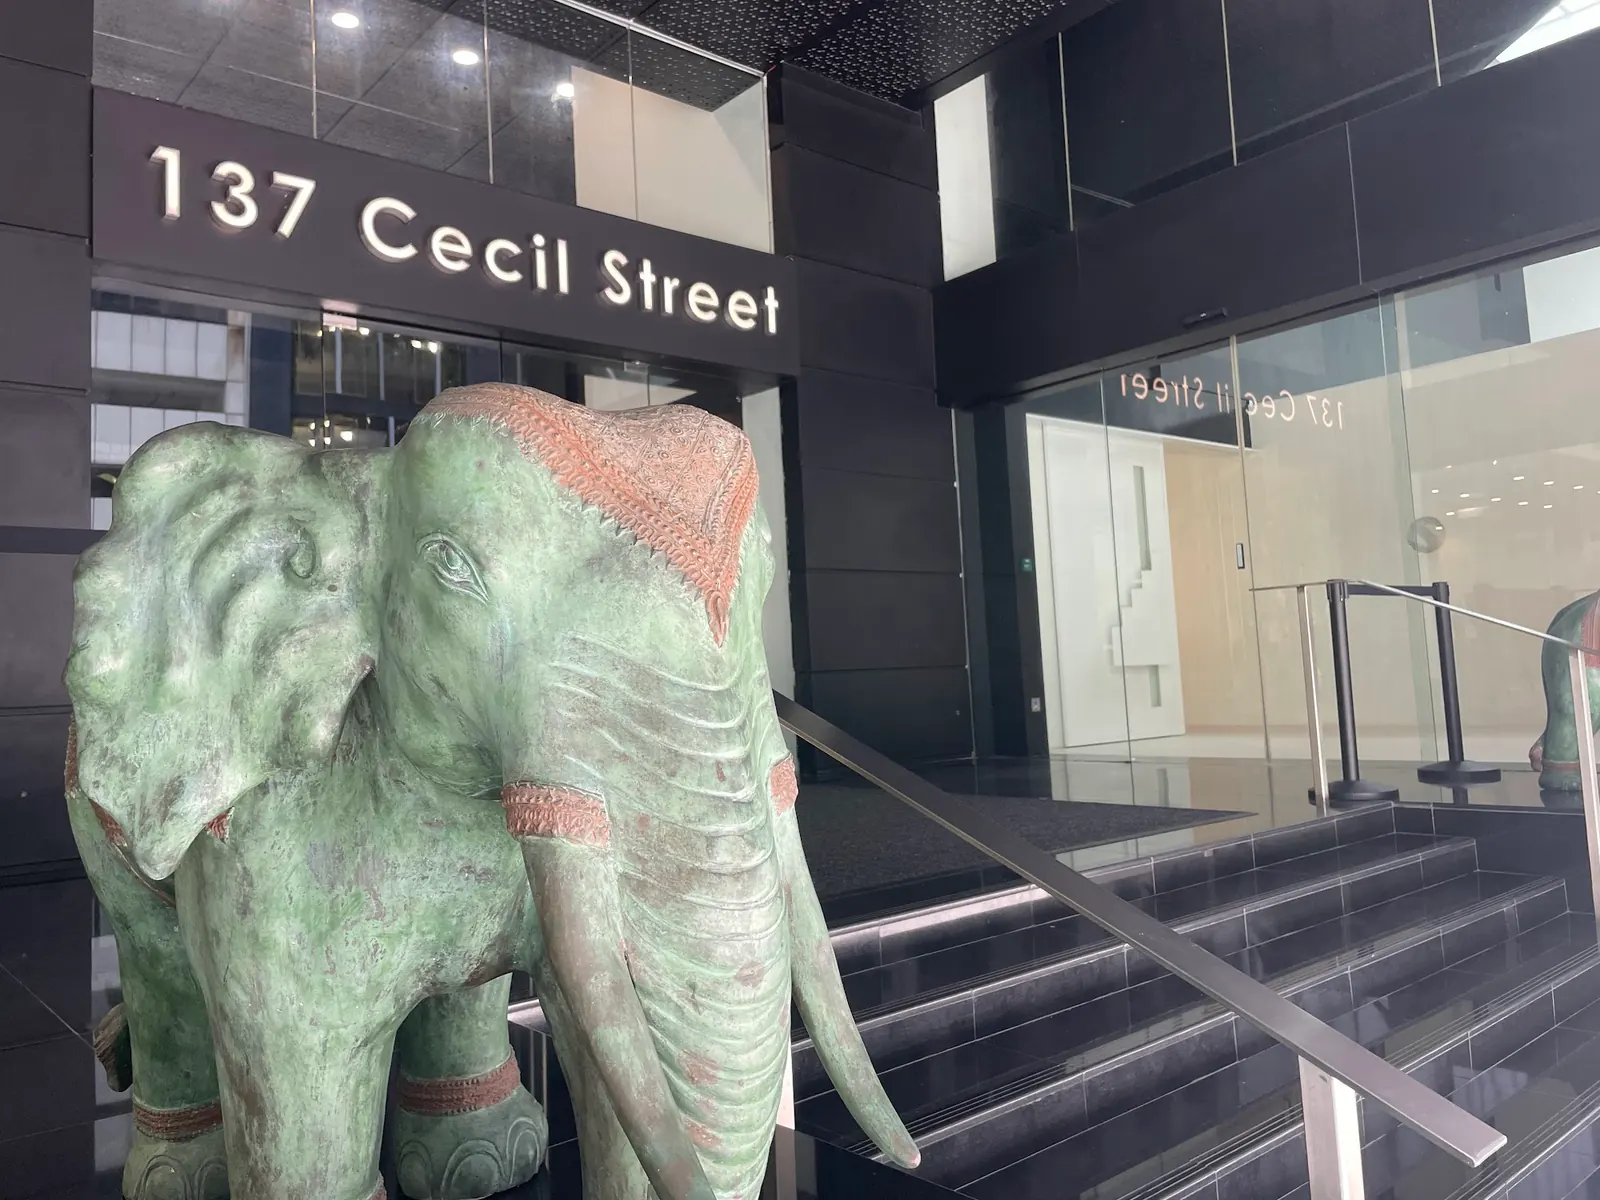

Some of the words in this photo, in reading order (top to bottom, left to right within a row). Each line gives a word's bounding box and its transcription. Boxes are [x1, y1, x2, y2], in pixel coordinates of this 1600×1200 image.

[149, 145, 317, 238] 137
[359, 196, 569, 295] Cecil
[600, 249, 779, 335] Street
